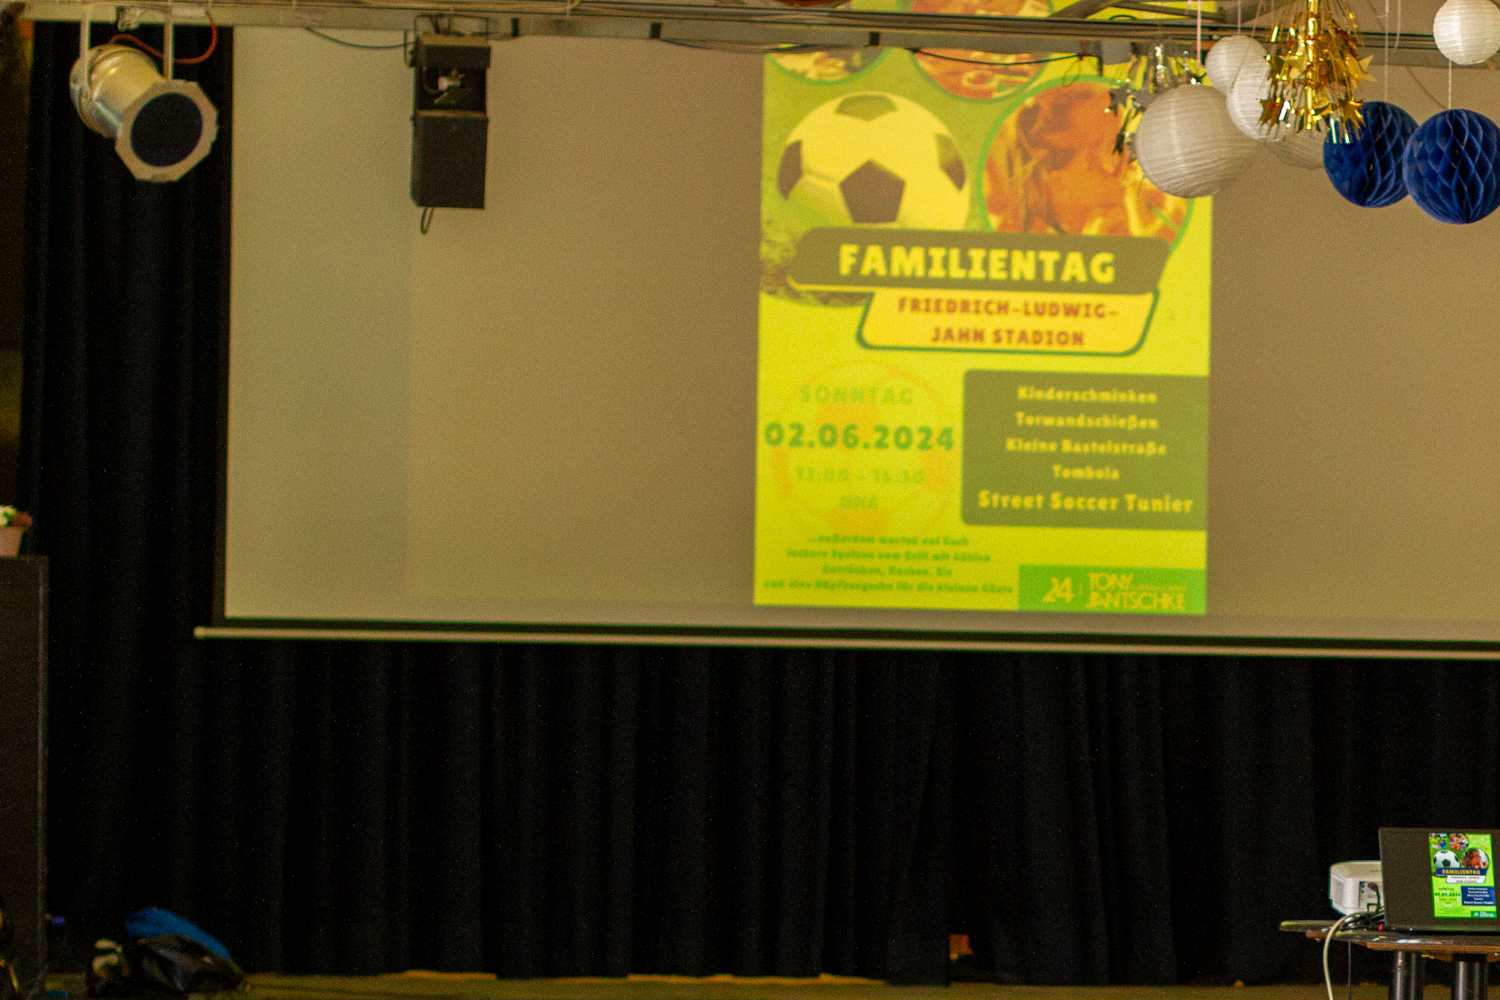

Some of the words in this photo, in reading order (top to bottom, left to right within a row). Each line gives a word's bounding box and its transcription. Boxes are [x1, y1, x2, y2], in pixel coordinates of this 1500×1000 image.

[839, 244, 1115, 284] FAMILIENTAG
[932, 327, 985, 343] JAHN
[993, 328, 1085, 346] STADION
[1017, 386, 1157, 403] Kinderschminken
[764, 421, 954, 451] 02.06.2024
[1006, 437, 1057, 452] Kleine
[1053, 464, 1120, 480] Tombola
[977, 490, 1044, 509] Street
[1050, 491, 1118, 511] Soccer
[1124, 493, 1193, 513] Tunier
